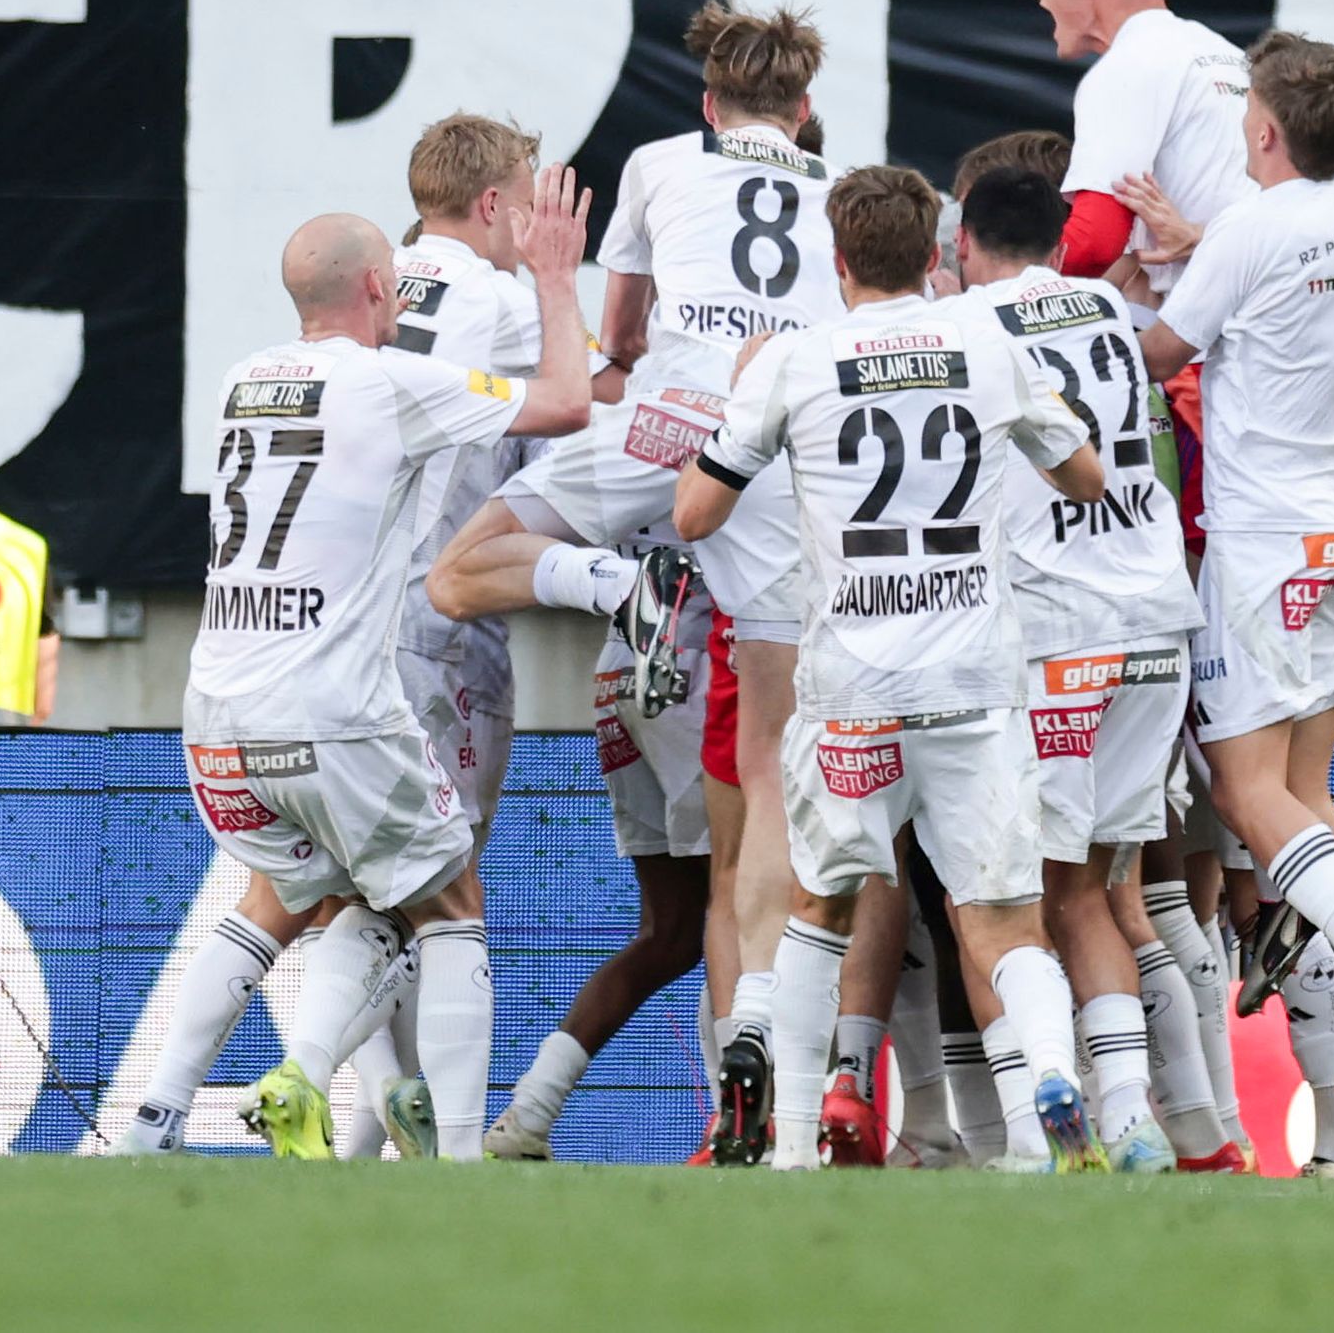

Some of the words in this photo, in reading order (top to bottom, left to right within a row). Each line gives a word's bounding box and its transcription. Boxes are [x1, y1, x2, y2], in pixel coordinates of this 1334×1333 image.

[731, 176, 800, 299] 8
[856, 353, 950, 385] SALANETTIS
[210, 427, 325, 571] 37
[837, 402, 982, 559] 22
[1051, 481, 1155, 544] PINK
[201, 585, 327, 632] IMMER
[830, 565, 991, 618] BAUMGARTNER
[818, 747, 897, 773] KLEINE
[826, 765, 900, 794] ZEITUNG
